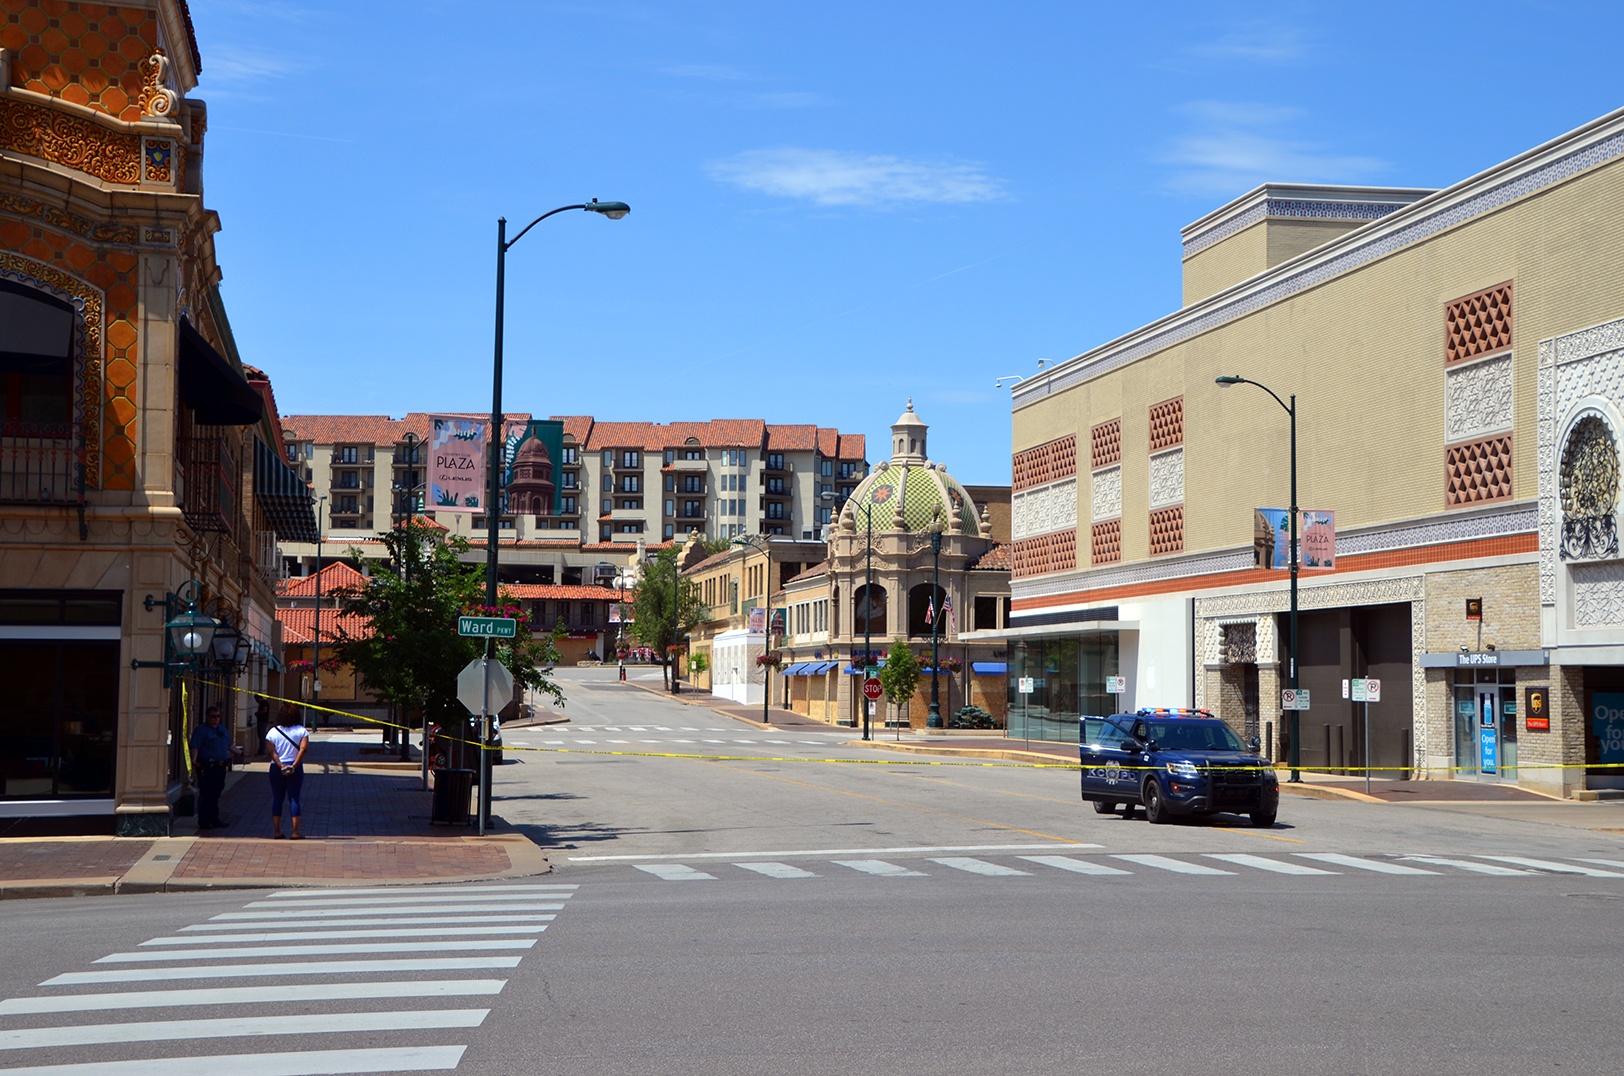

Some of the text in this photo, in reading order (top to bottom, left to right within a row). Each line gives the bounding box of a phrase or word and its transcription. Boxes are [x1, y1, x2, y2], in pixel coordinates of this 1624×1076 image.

[436, 456, 475, 470] PLAZA
[1306, 534, 1330, 544] PLAZA
[461, 620, 512, 635] Ward PKWY
[1459, 653, 1498, 664] The UPS Store
[865, 685, 882, 693] STOP
[1605, 724, 1624, 740] fo
[1481, 734, 1496, 745] Open
[1485, 746, 1493, 755] for
